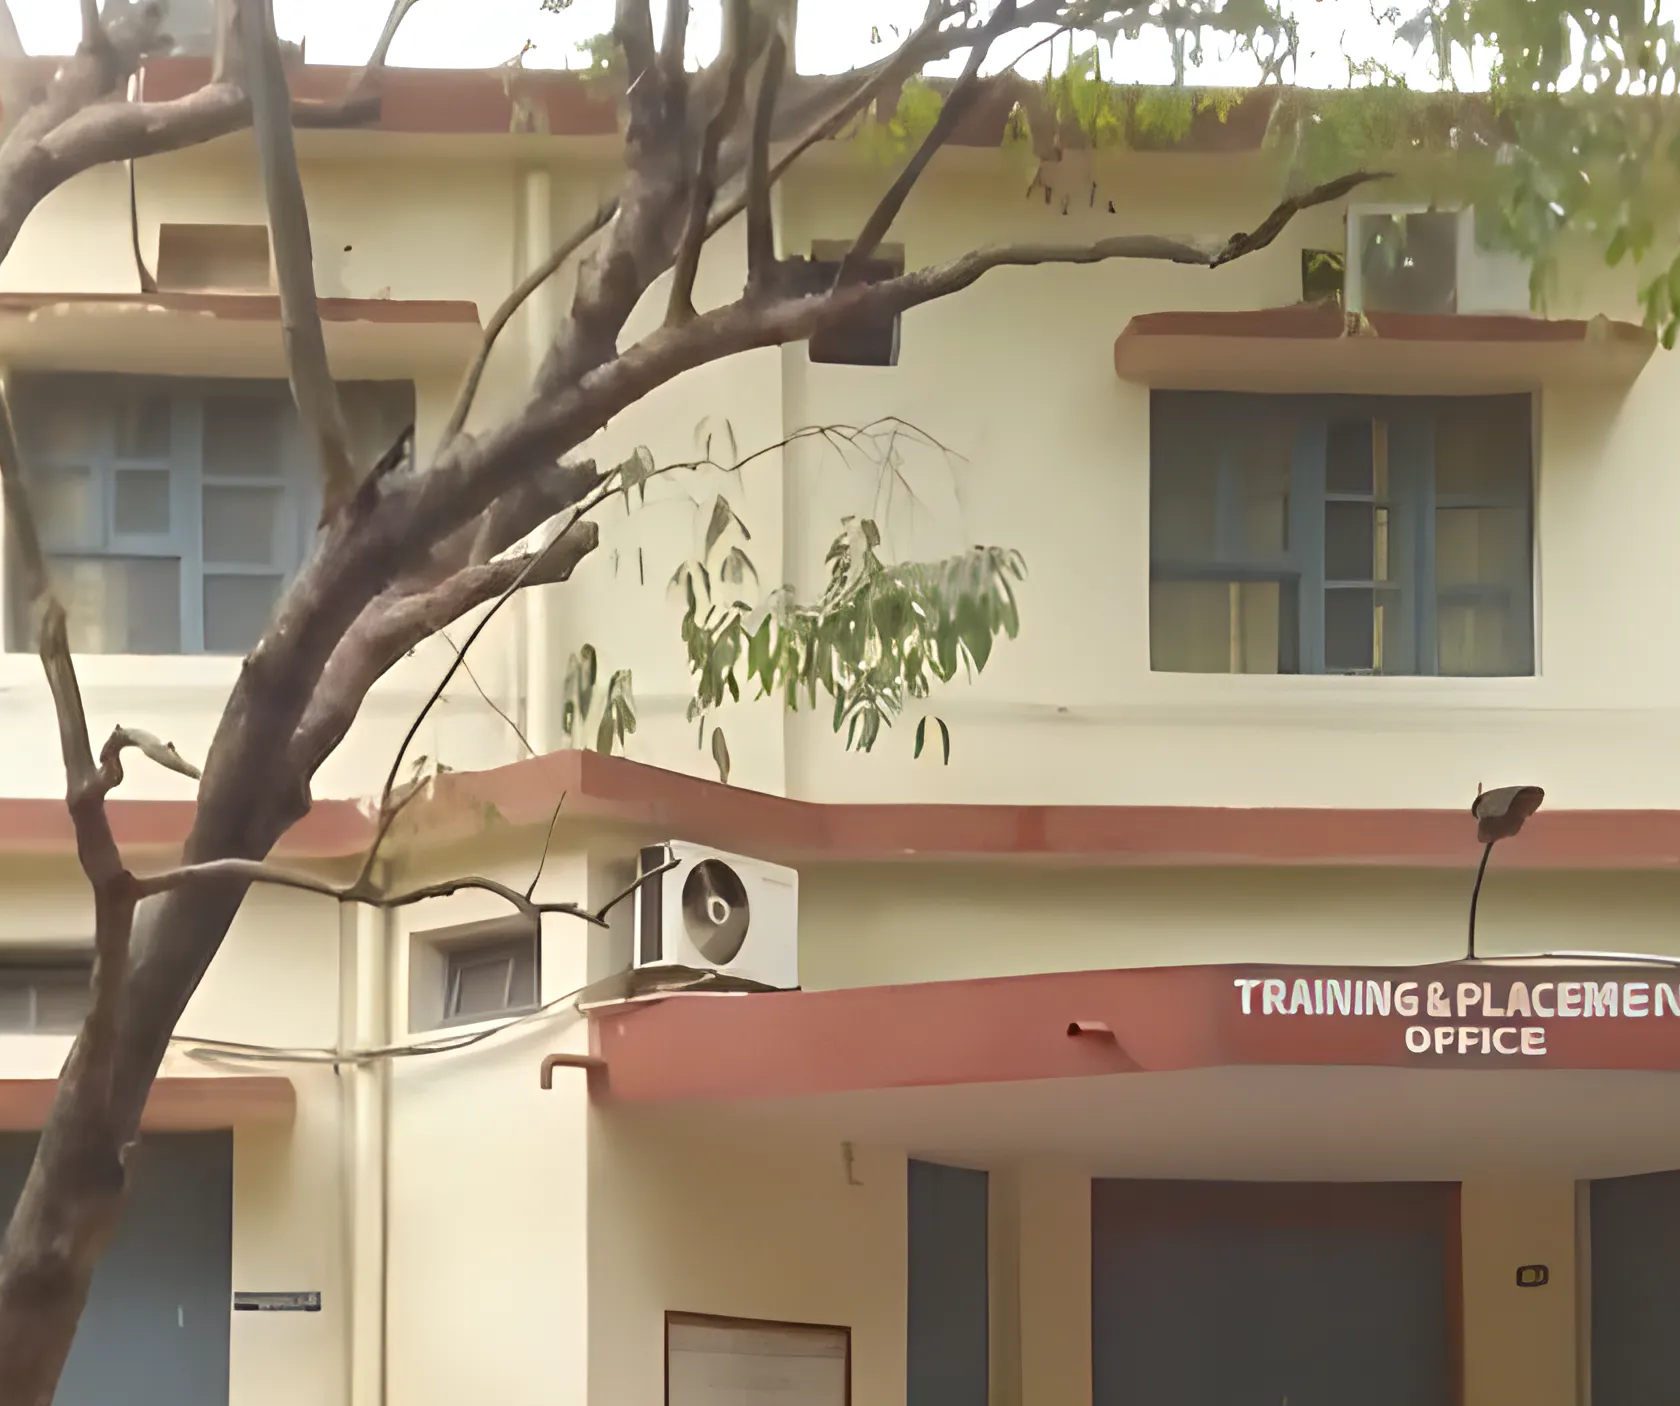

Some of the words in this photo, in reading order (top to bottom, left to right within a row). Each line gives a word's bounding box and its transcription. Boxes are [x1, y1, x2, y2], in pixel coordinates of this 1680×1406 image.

[1232, 977, 1419, 1017] TRAINING
[1425, 980, 1452, 1018] &
[1404, 1024, 1548, 1056] OFFICE
